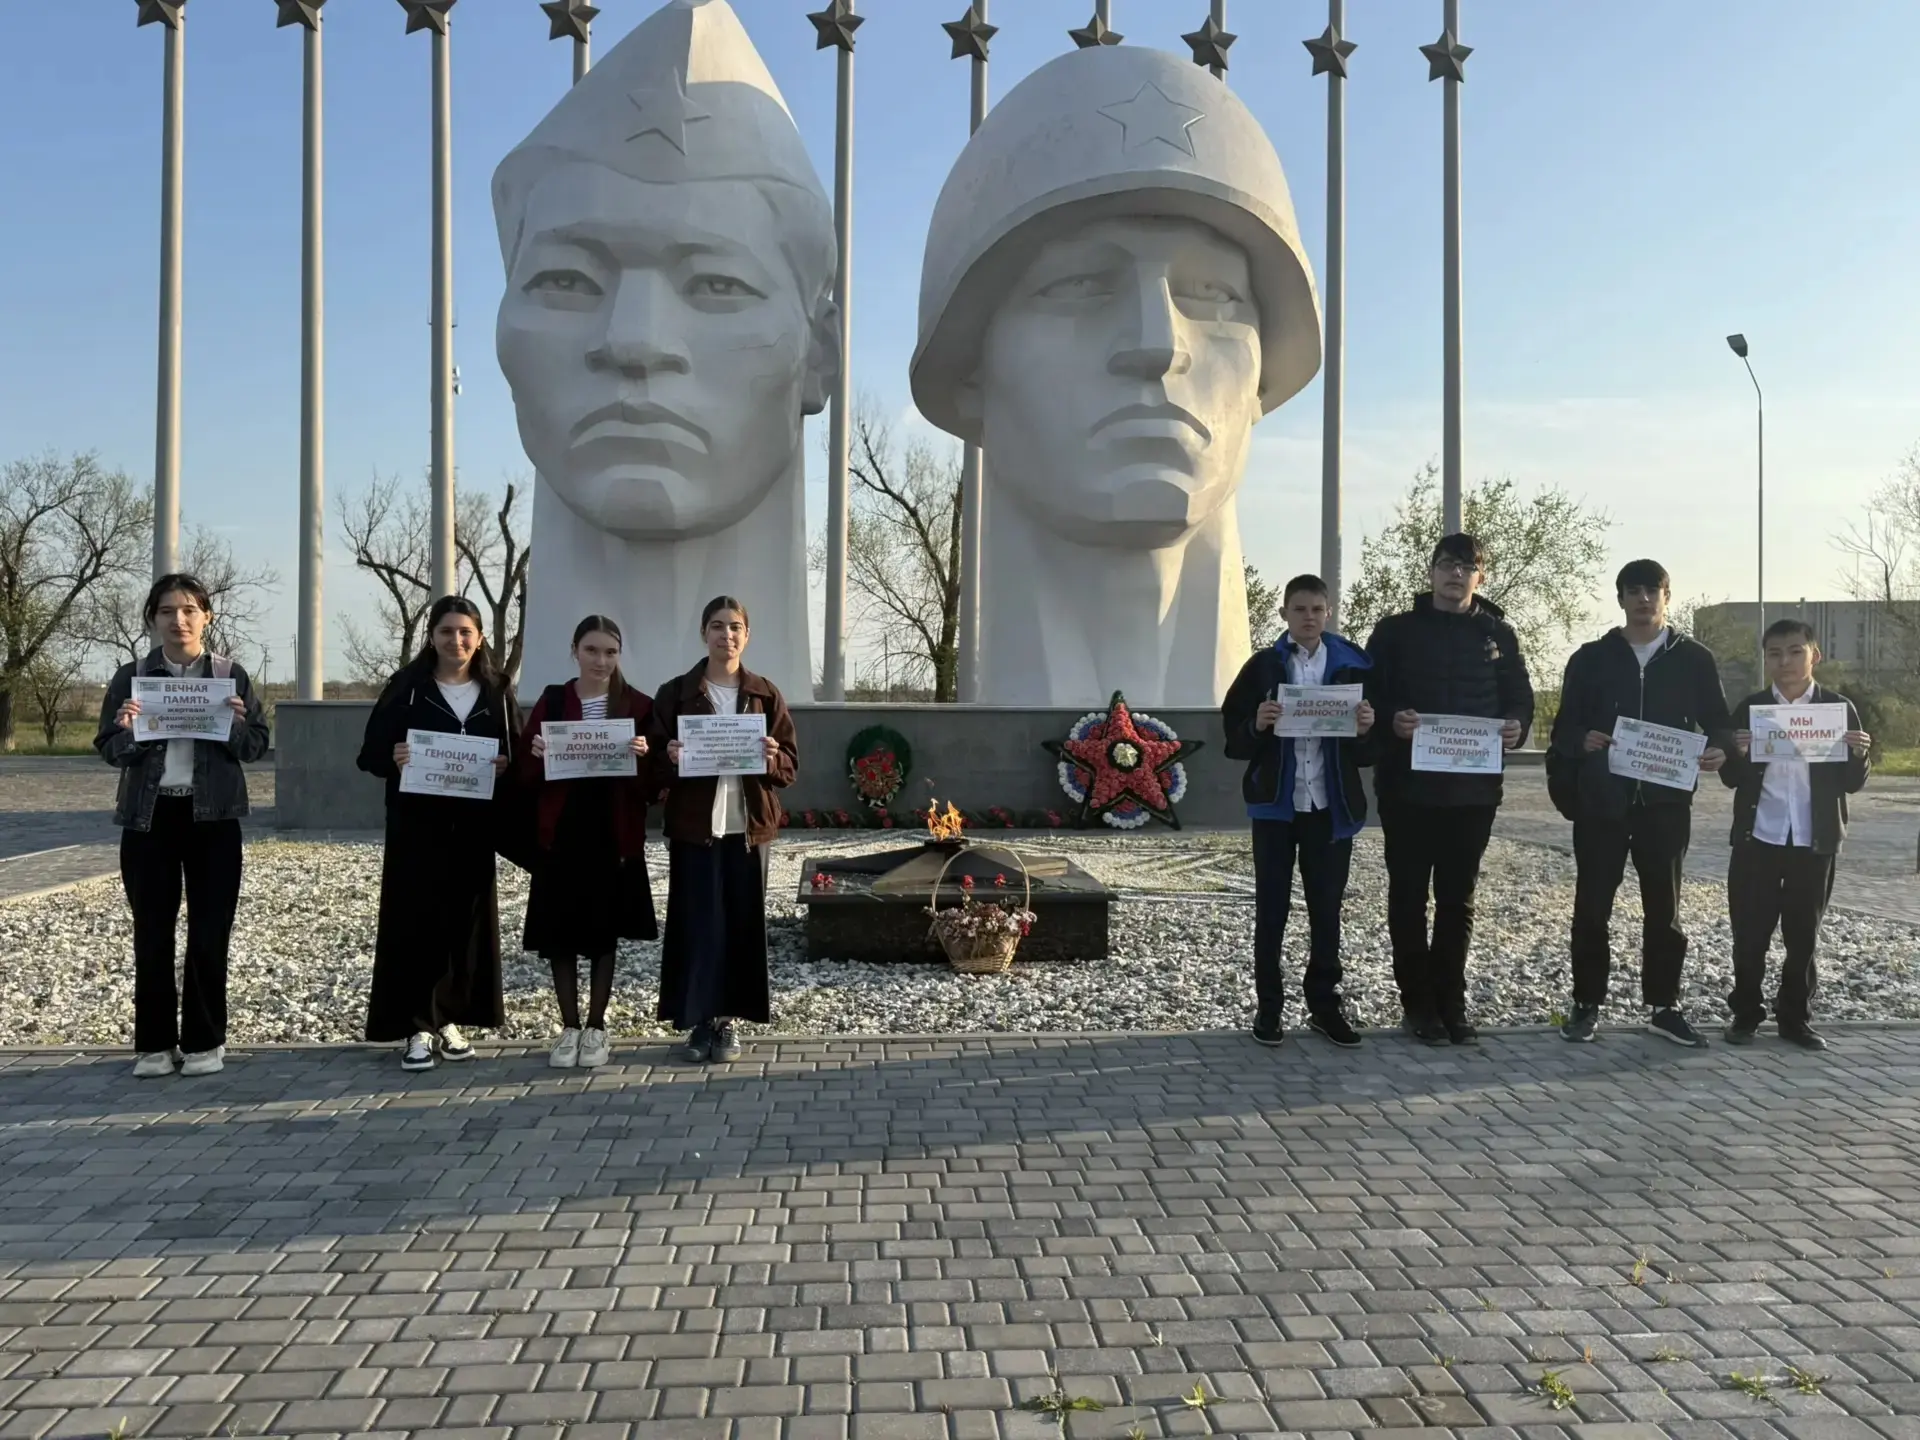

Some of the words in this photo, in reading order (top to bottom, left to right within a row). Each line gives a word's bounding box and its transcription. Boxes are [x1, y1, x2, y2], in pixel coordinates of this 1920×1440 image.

[165, 684, 208, 692] ВЕЧНАЯ
[163, 696, 210, 704] ПАМЯТЬ
[1293, 709, 1348, 717] ДАВНОСТИ
[1790, 717, 1813, 726] МЫ
[572, 731, 592, 740] ЭТО
[595, 731, 609, 740] НЕ
[1432, 726, 1488, 737] НЕУГАСИМА
[1768, 729, 1835, 739] ПОМНИМ!
[1440, 736, 1479, 746] ПАМЯТЬ
[1643, 731, 1682, 746] ЗАБЫТЬ
[566, 742, 616, 752] ДОЛЖНО
[1428, 746, 1490, 757] ПОКОЛЕНИЙ
[1636, 741, 1673, 753] НЕЛЬЗЯ
[425, 748, 477, 764] ГЕНОЦИД
[555, 752, 628, 761] ПОВТОРИТЬСЯ!
[1627, 748, 1688, 768] ВСПОМНИТЬ
[444, 762, 464, 772] ЭТО
[425, 773, 479, 786] СТРАШНО
